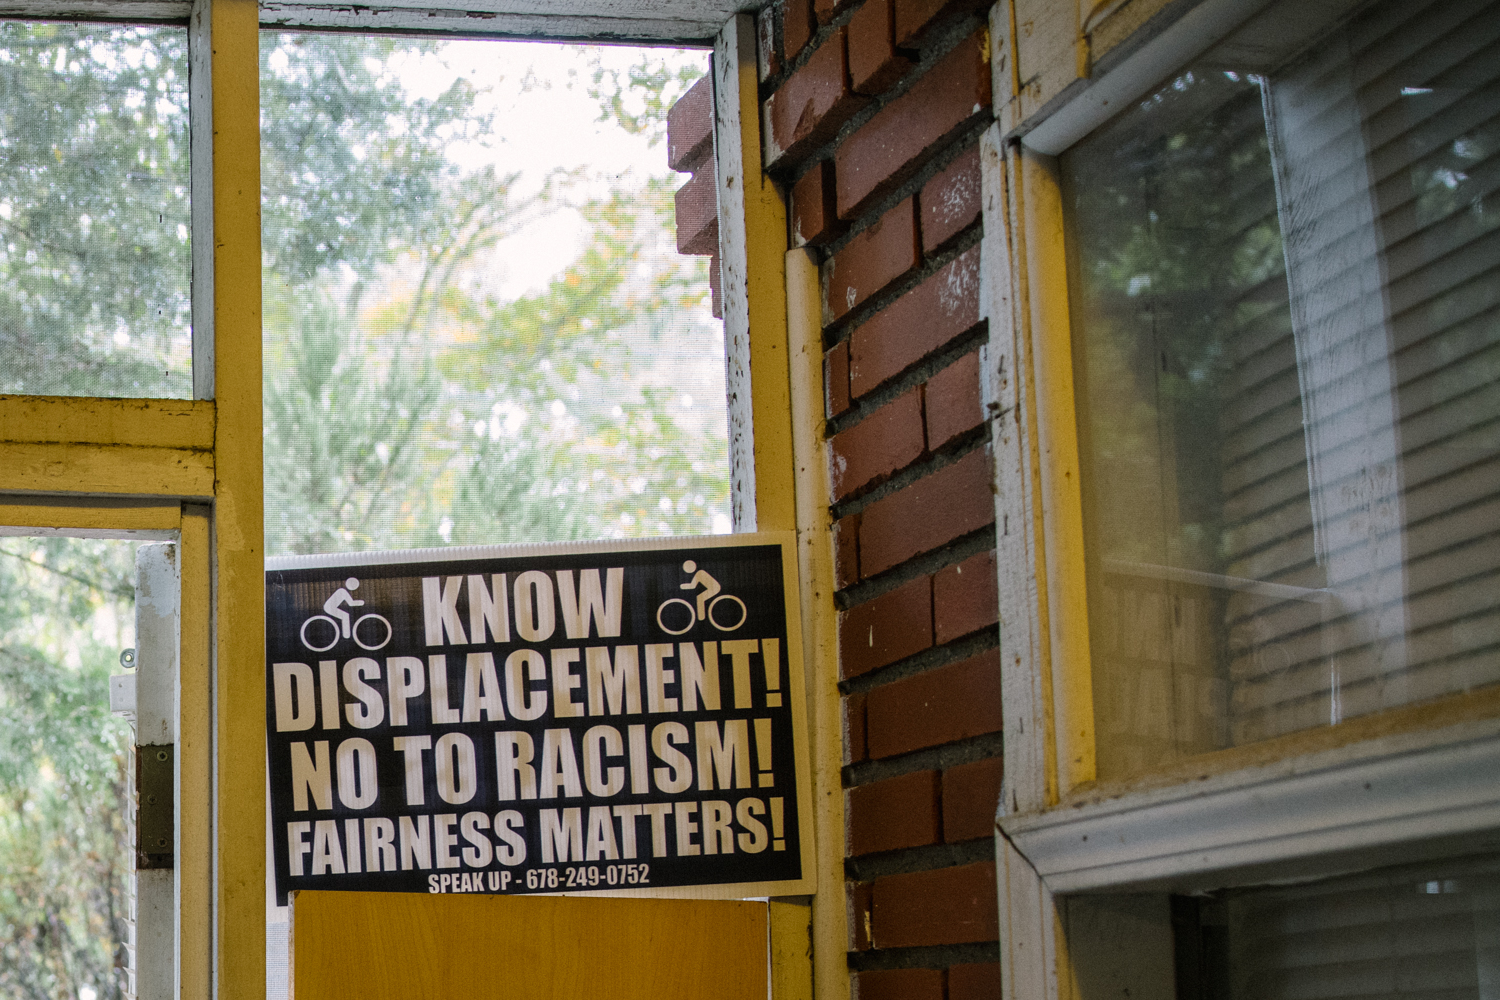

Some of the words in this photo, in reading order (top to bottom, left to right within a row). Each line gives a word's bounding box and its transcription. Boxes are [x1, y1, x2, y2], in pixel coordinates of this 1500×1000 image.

[421, 567, 624, 647] KNOW
[272, 637, 783, 733] DISPLACEMENT!
[290, 737, 379, 812] NO
[393, 732, 476, 805] TO
[494, 717, 774, 801] RACISM!
[287, 809, 527, 876] FAIRNESS
[539, 797, 787, 865] MATTERS!
[428, 872, 485, 894] SPEAK
[488, 871, 511, 891] UP
[526, 863, 650, 889] 678-249-0752
